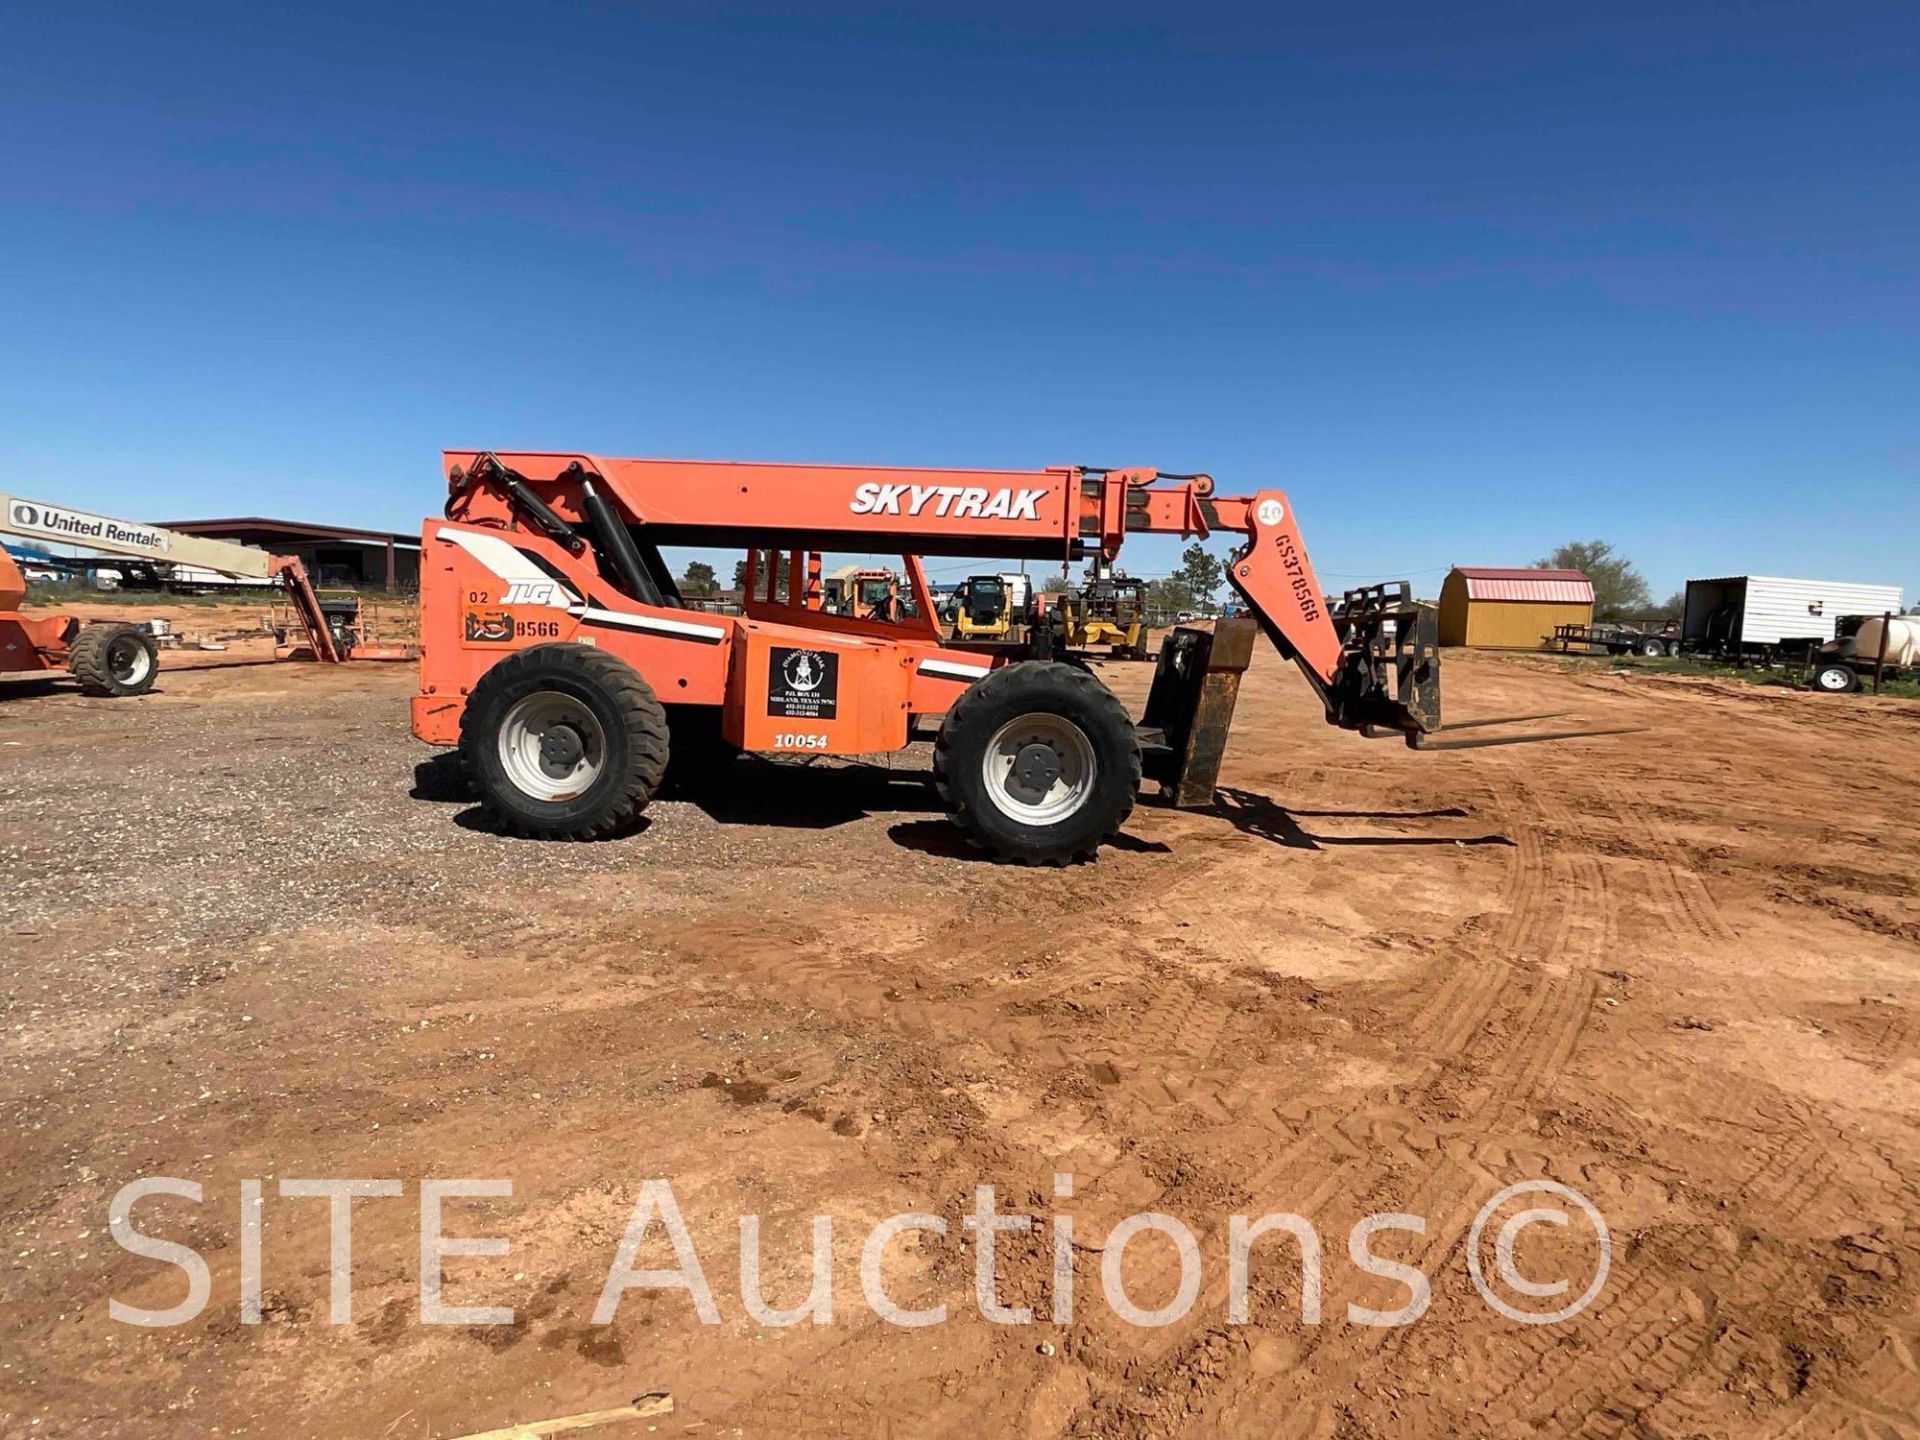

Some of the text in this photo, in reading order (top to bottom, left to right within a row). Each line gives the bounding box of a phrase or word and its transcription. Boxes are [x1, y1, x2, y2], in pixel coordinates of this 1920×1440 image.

[849, 482, 1049, 520] SKYTRAK
[1261, 505, 1282, 519] 10
[43, 511, 162, 548] United Rentals
[498, 584, 555, 604] JLG
[516, 621, 560, 637] 8566
[800, 697, 820, 705] TEXAS
[774, 734, 828, 749] 10054
